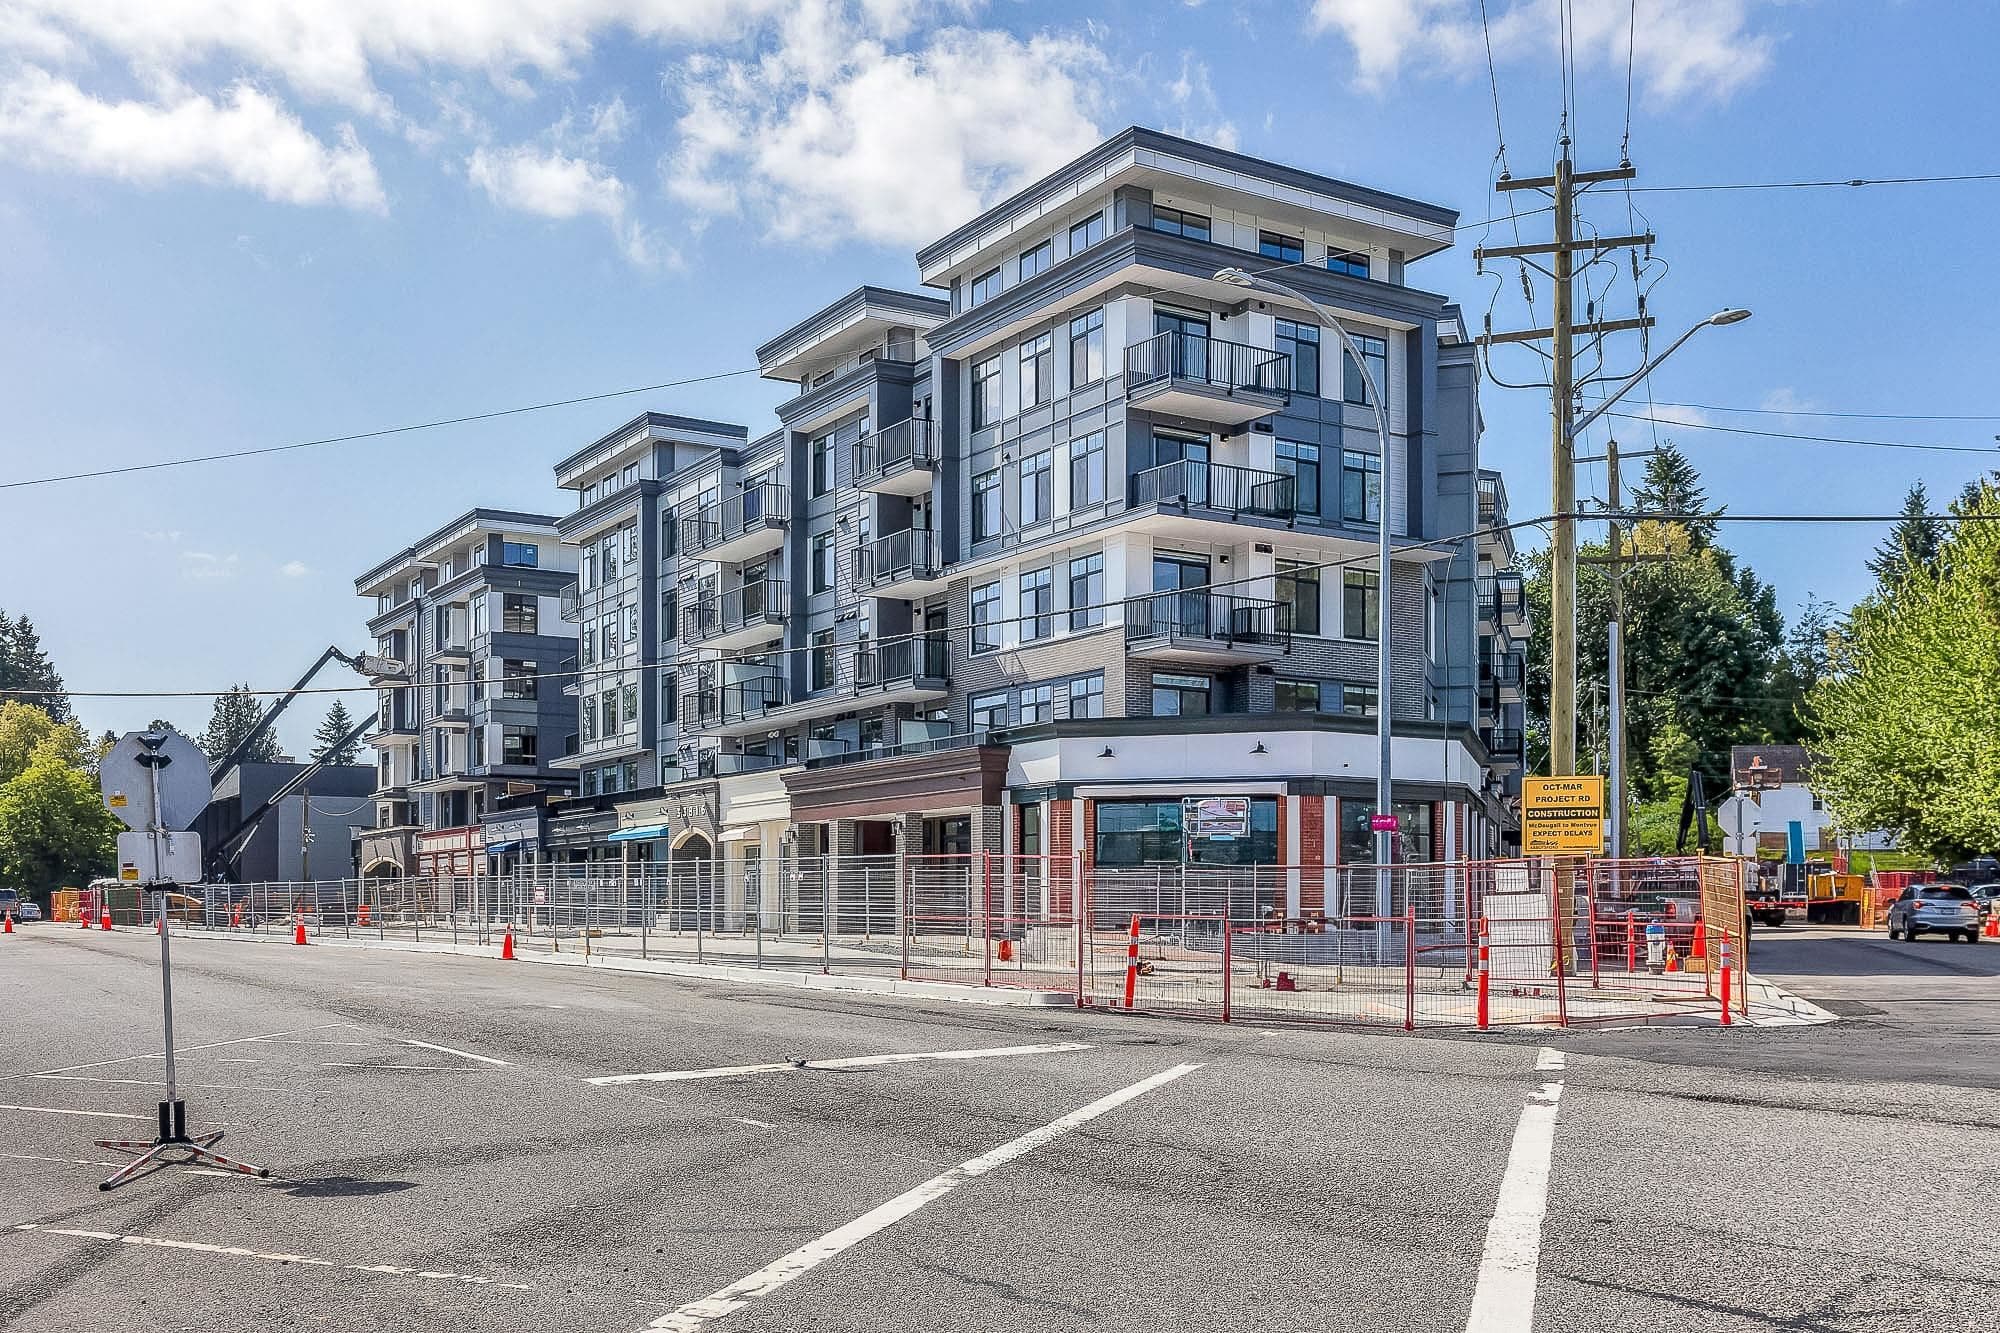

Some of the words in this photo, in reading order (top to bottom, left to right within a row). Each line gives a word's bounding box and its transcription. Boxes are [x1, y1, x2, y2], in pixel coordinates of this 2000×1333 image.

[1543, 783, 1583, 791] OCT-MAR
[1535, 795, 1577, 803] PROJECT
[1527, 809, 1599, 818] CONSTRUCTION
